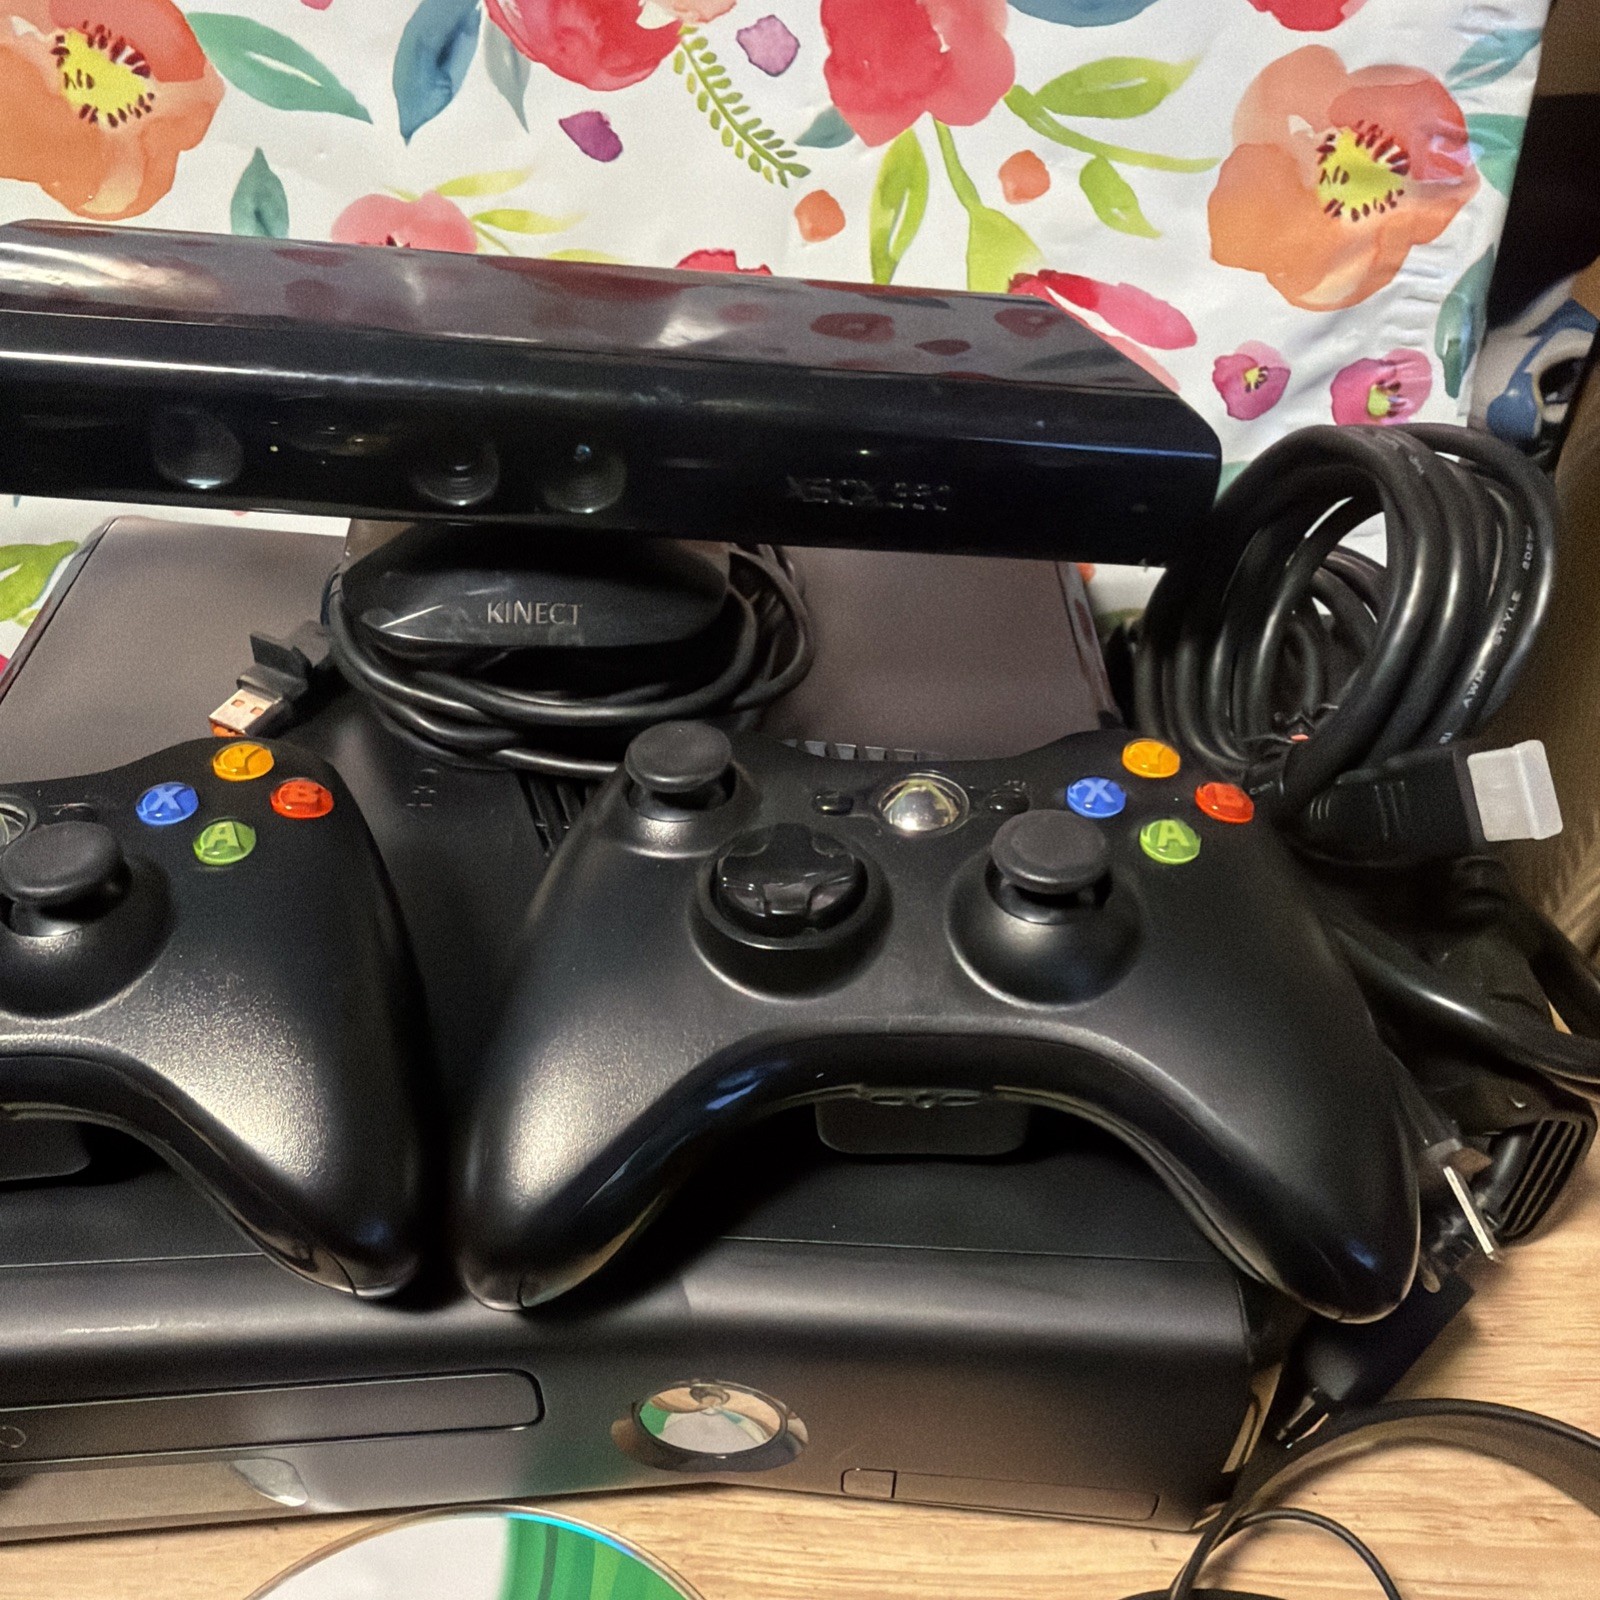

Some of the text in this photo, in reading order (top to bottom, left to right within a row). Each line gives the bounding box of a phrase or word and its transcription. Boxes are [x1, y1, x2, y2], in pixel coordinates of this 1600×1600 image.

[487, 600, 582, 625] KINECT
[149, 785, 185, 811] X
[1081, 778, 1116, 804] X
[203, 821, 241, 848] A
[1157, 819, 1191, 847] A
